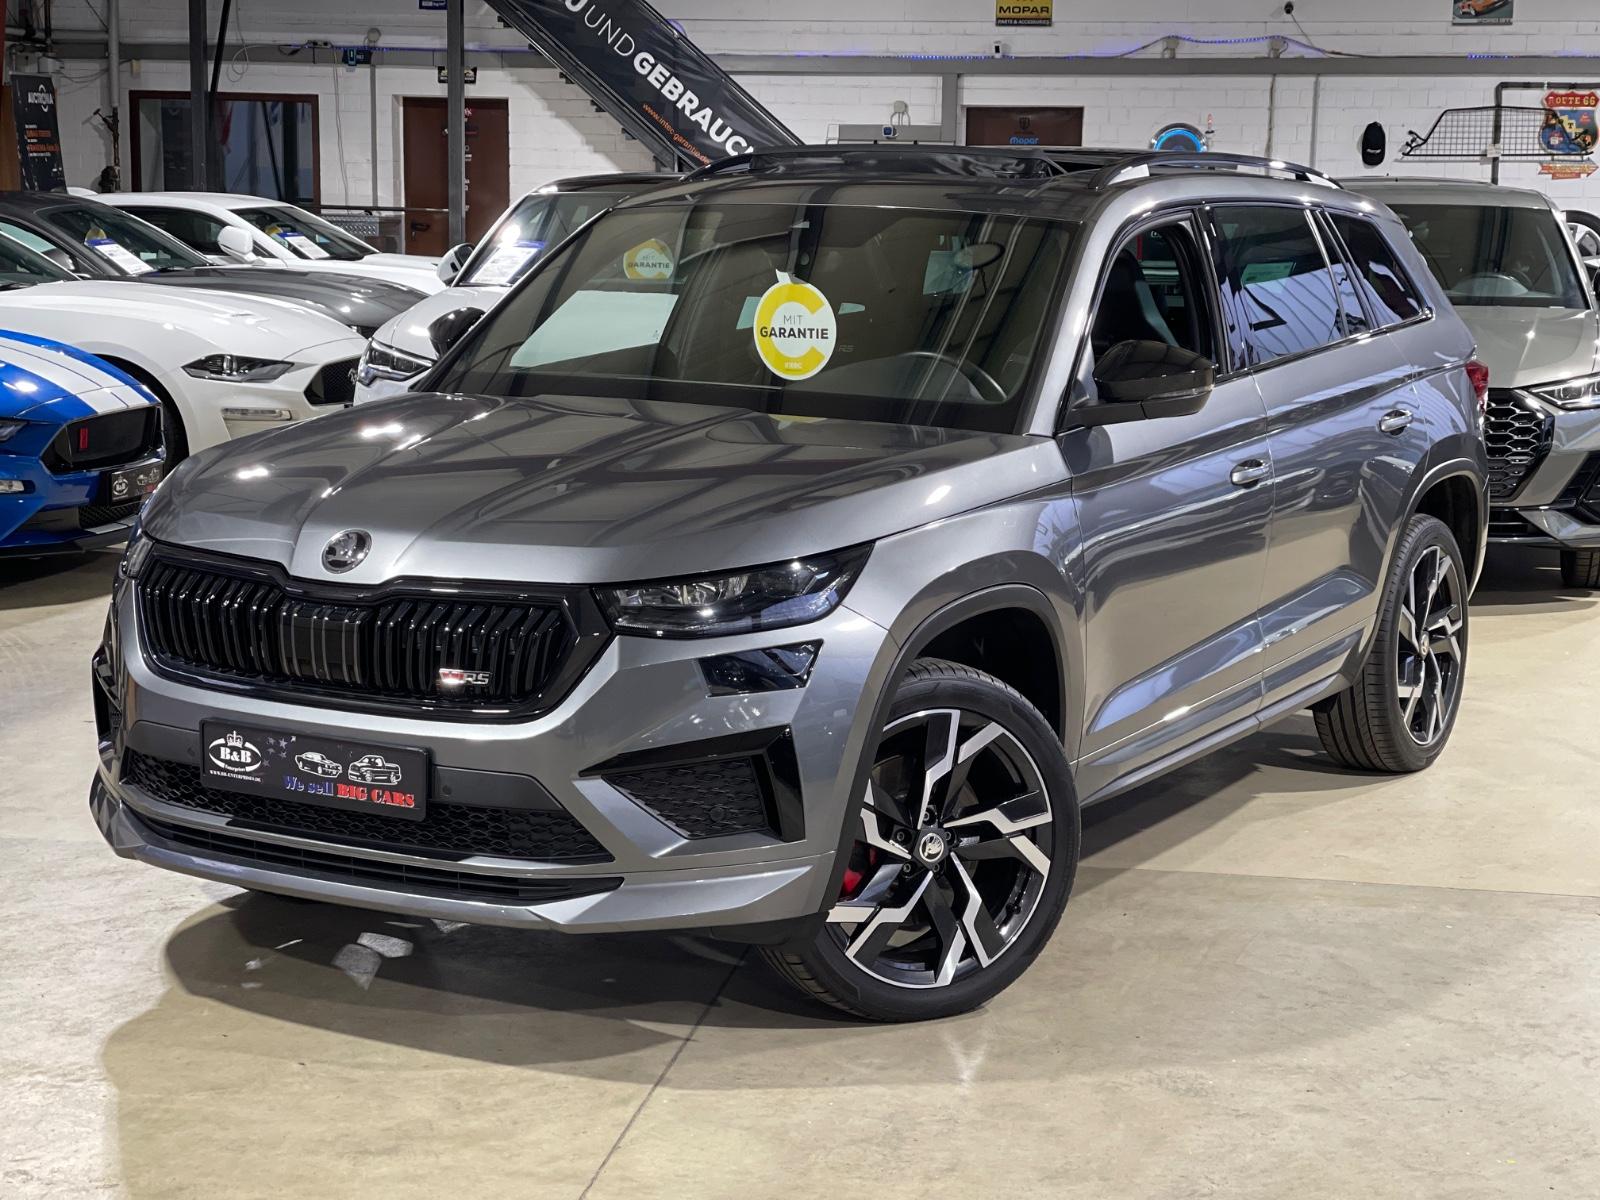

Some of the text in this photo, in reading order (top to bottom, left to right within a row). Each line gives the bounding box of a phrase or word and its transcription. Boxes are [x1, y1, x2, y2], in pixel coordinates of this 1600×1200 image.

[999, 6, 1050, 14] MOPAR
[585, 5, 754, 156] UND GEBRAUC
[1548, 96, 1596, 105] ROUTE 66
[627, 261, 671, 270] GARANTIE
[783, 314, 803, 325] MIT
[759, 326, 829, 340] GARANTIE
[220, 746, 251, 763] B&B
[284, 775, 415, 808] We sell BIG CARS
